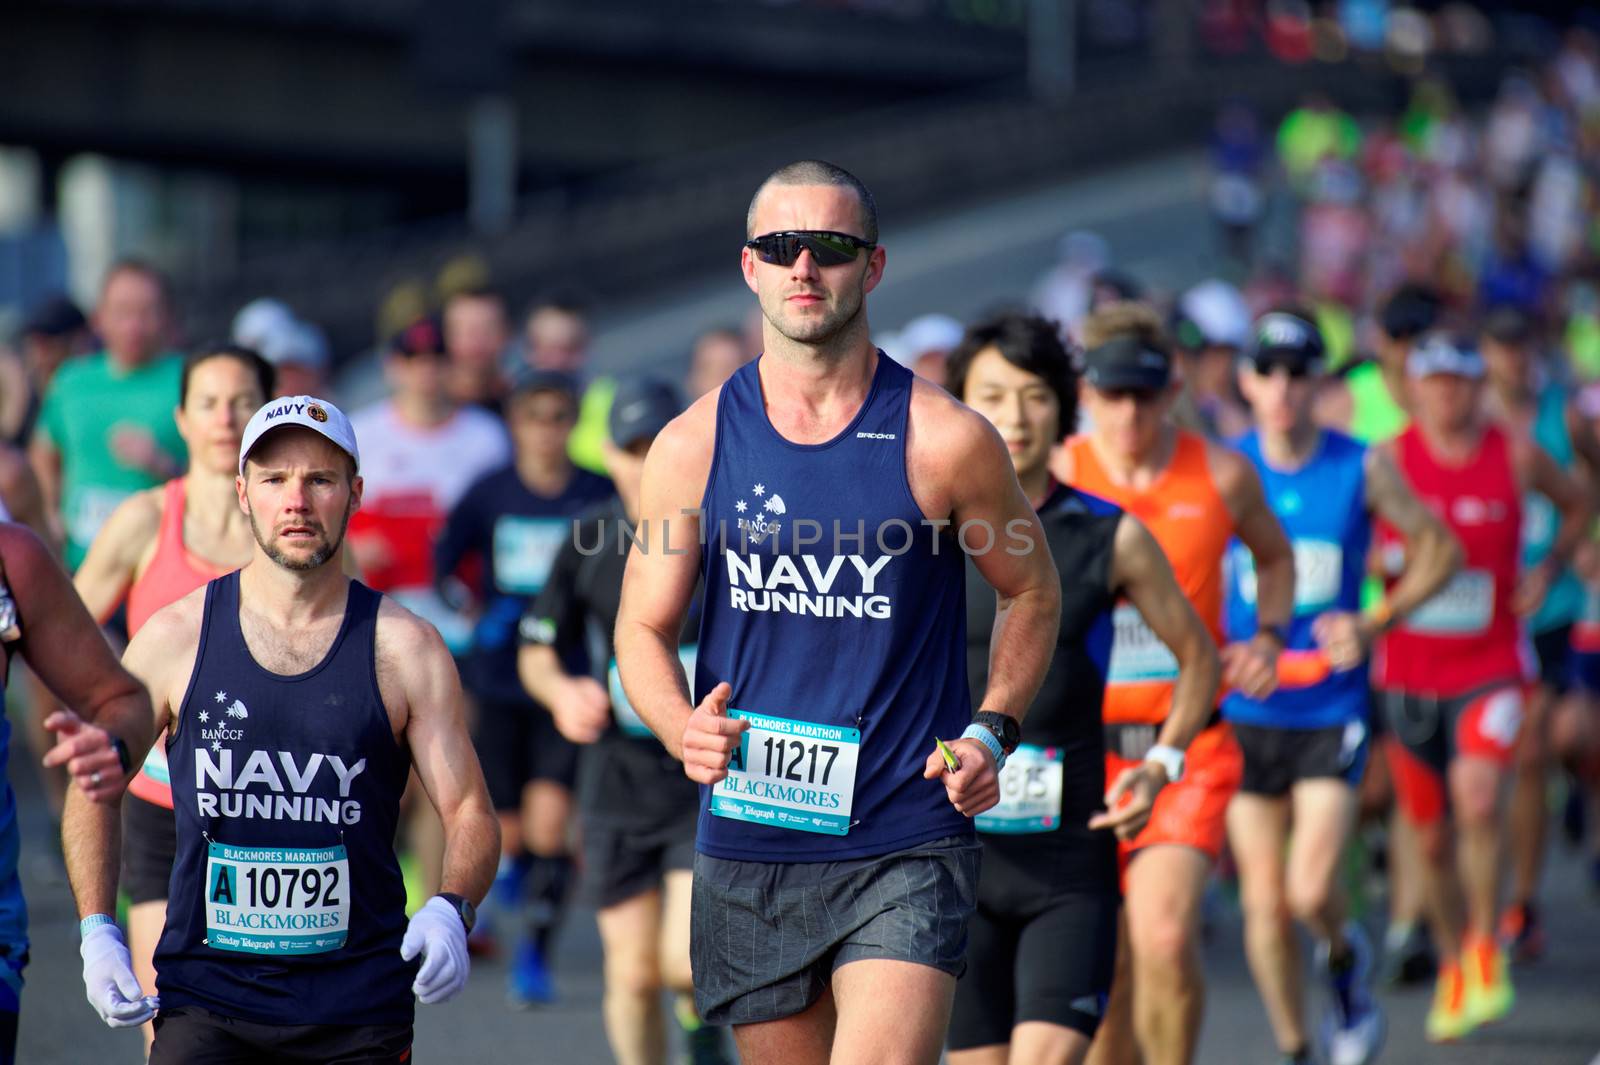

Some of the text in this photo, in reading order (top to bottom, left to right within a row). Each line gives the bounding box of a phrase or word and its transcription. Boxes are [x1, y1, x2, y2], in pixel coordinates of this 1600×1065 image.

[265, 404, 305, 422] NAVY
[856, 431, 896, 440] BROOKS
[726, 548, 893, 594] NAVY
[730, 586, 892, 619] RUNNING
[201, 728, 244, 740] RANCCF
[793, 725, 842, 740] MARATHON
[195, 748, 367, 797] NAVY
[764, 737, 840, 786] 11217
[723, 776, 841, 809] BLACKMORES
[196, 792, 362, 825] RUNNING
[223, 848, 334, 862] BLACKMORES MARATHON
[213, 865, 340, 909] A 10792
[215, 909, 340, 929] BLACKMORES
[216, 934, 241, 948] Sunday
[240, 937, 276, 950] Telegraph
